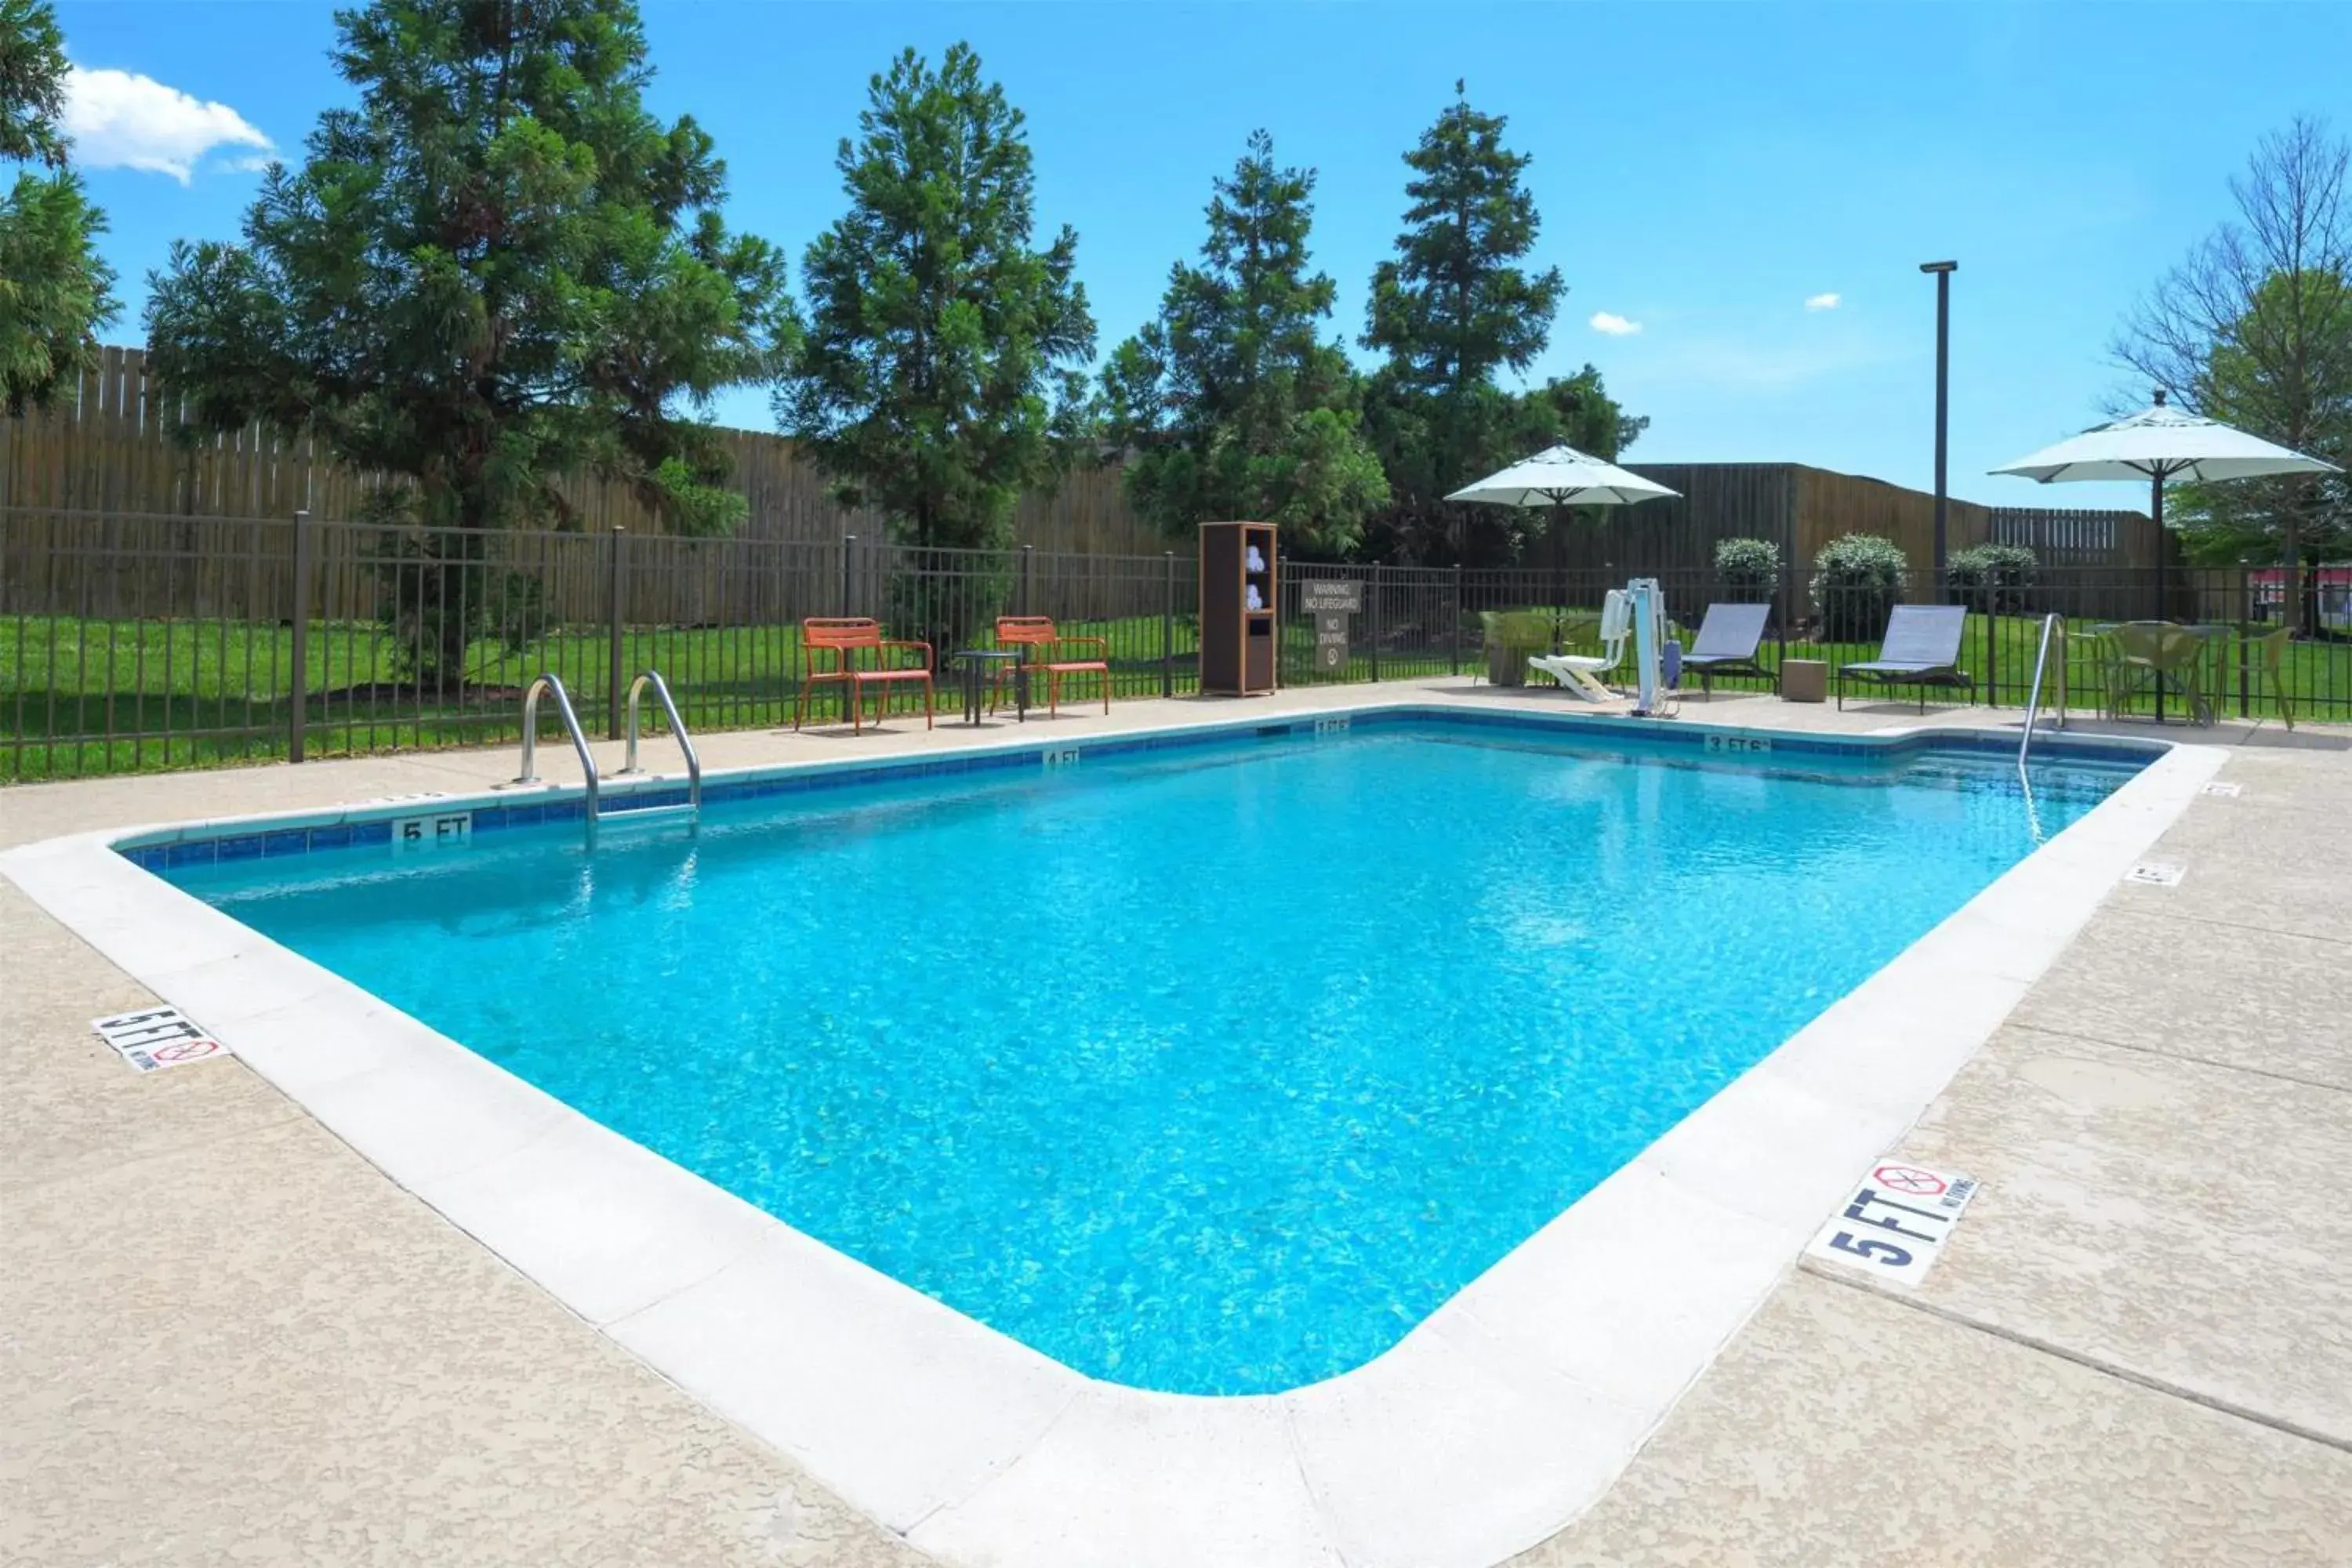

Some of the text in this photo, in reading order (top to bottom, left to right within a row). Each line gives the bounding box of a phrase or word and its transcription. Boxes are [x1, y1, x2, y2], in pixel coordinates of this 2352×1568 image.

[1313, 583, 1349, 595] WARNING
[1305, 597, 1318, 609] NO
[1327, 618, 1339, 630] NO
[1319, 631, 1347, 644] DIVING
[1728, 738, 1747, 753] FT
[404, 815, 468, 842] 5 FT
[100, 1010, 203, 1049] 5 FT
[1828, 1188, 1949, 1267] 5 FT
